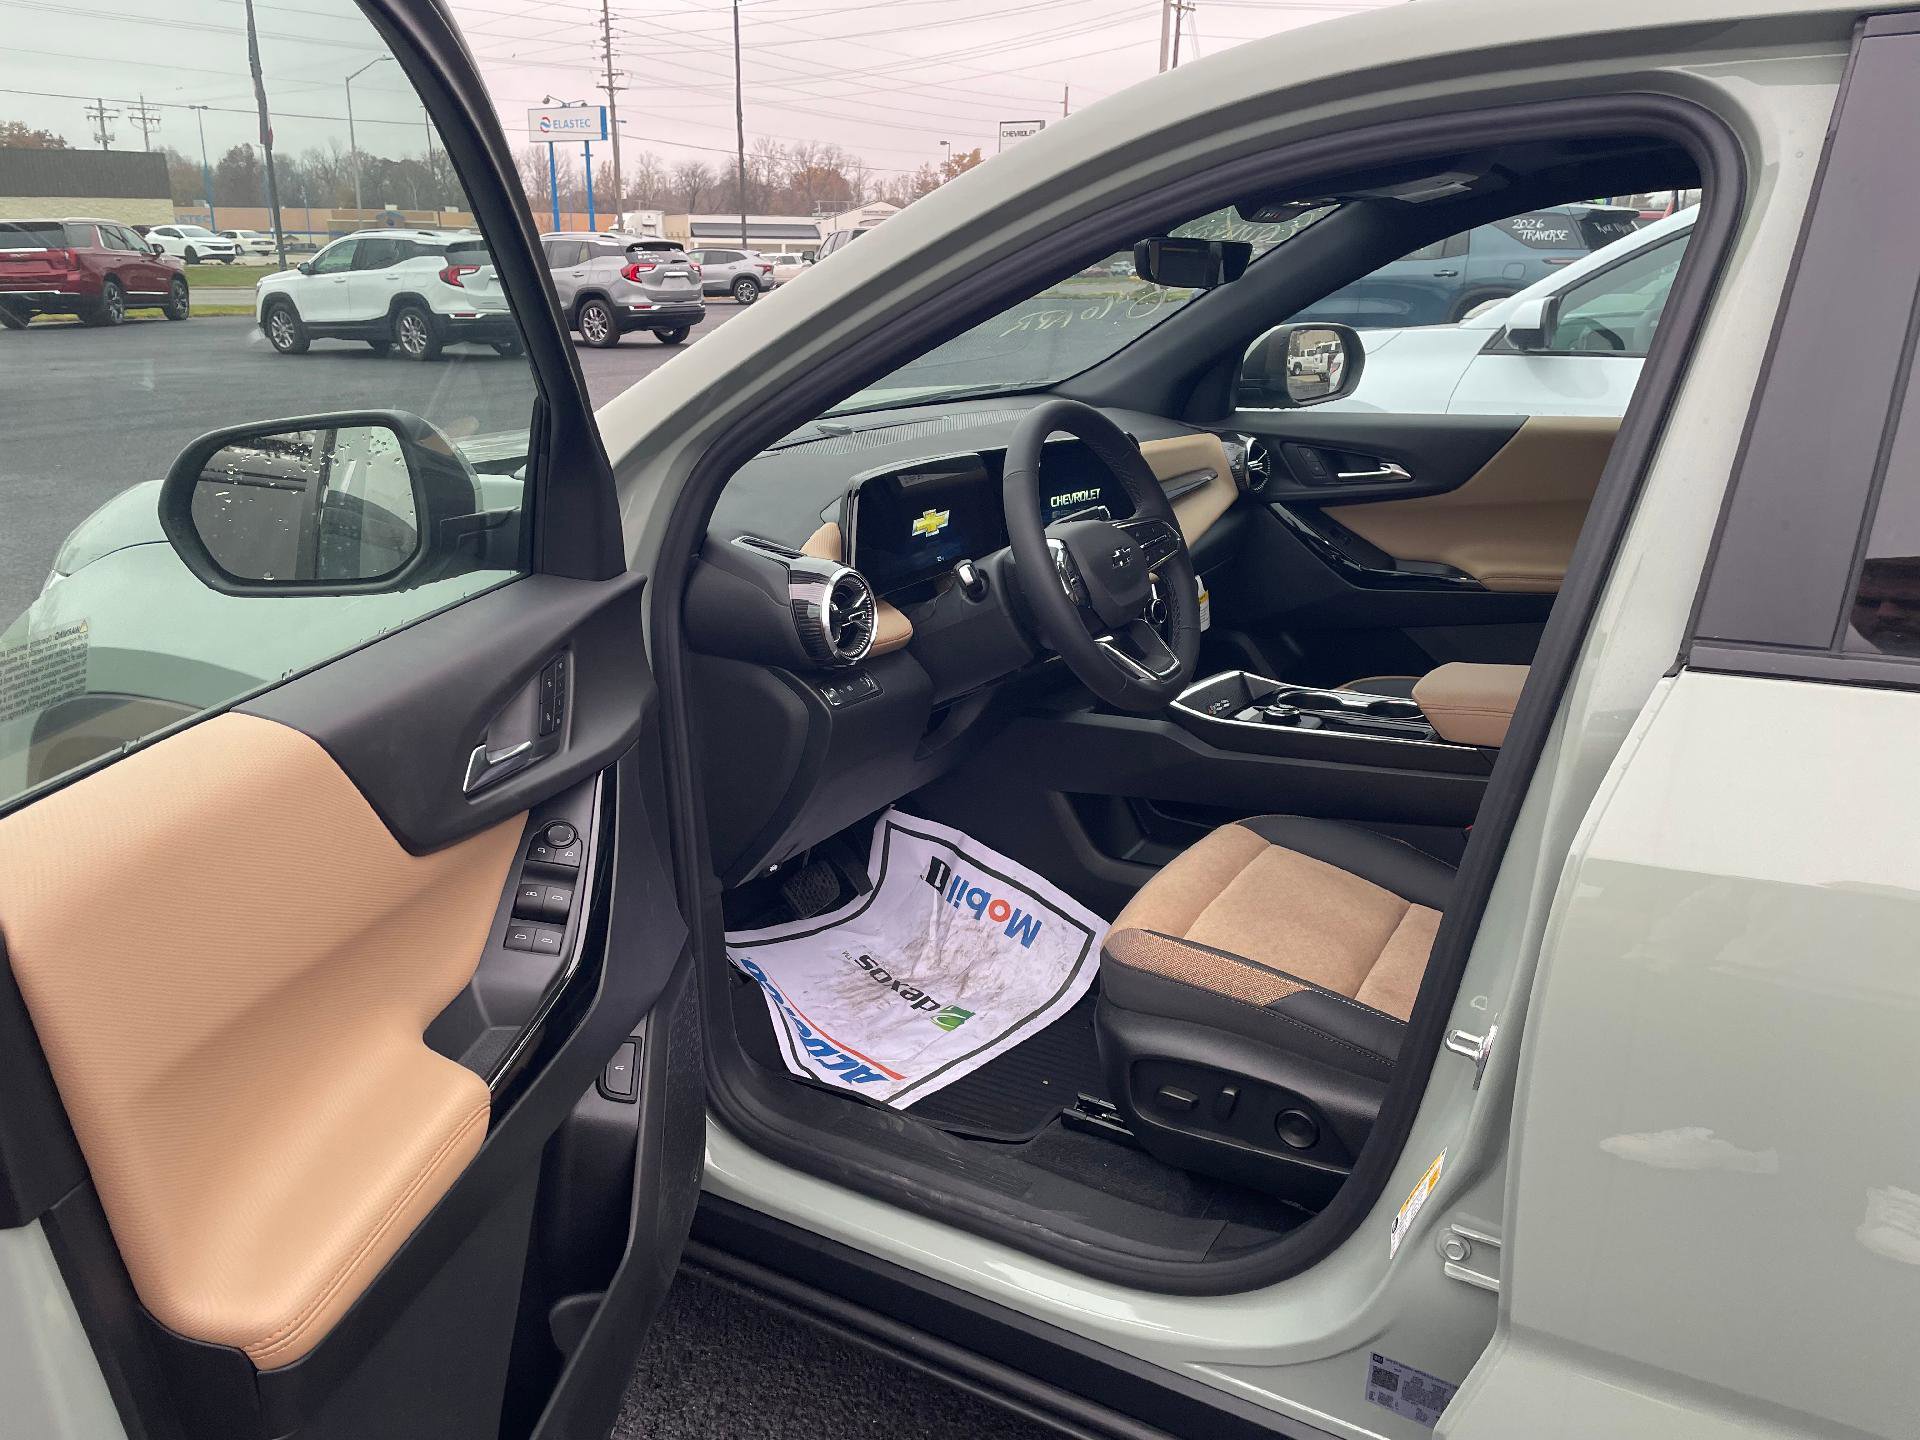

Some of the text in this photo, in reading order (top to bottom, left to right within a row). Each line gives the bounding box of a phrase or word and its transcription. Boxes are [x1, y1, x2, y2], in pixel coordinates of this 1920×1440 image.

[553, 118, 591, 130] ELASTEC
[1512, 218, 1545, 229] 2026
[1518, 229, 1569, 242] TRAVERSE
[1050, 488, 1101, 508] CHEVROLET
[946, 874, 1043, 949] Mobil
[855, 953, 942, 1014] dexos
